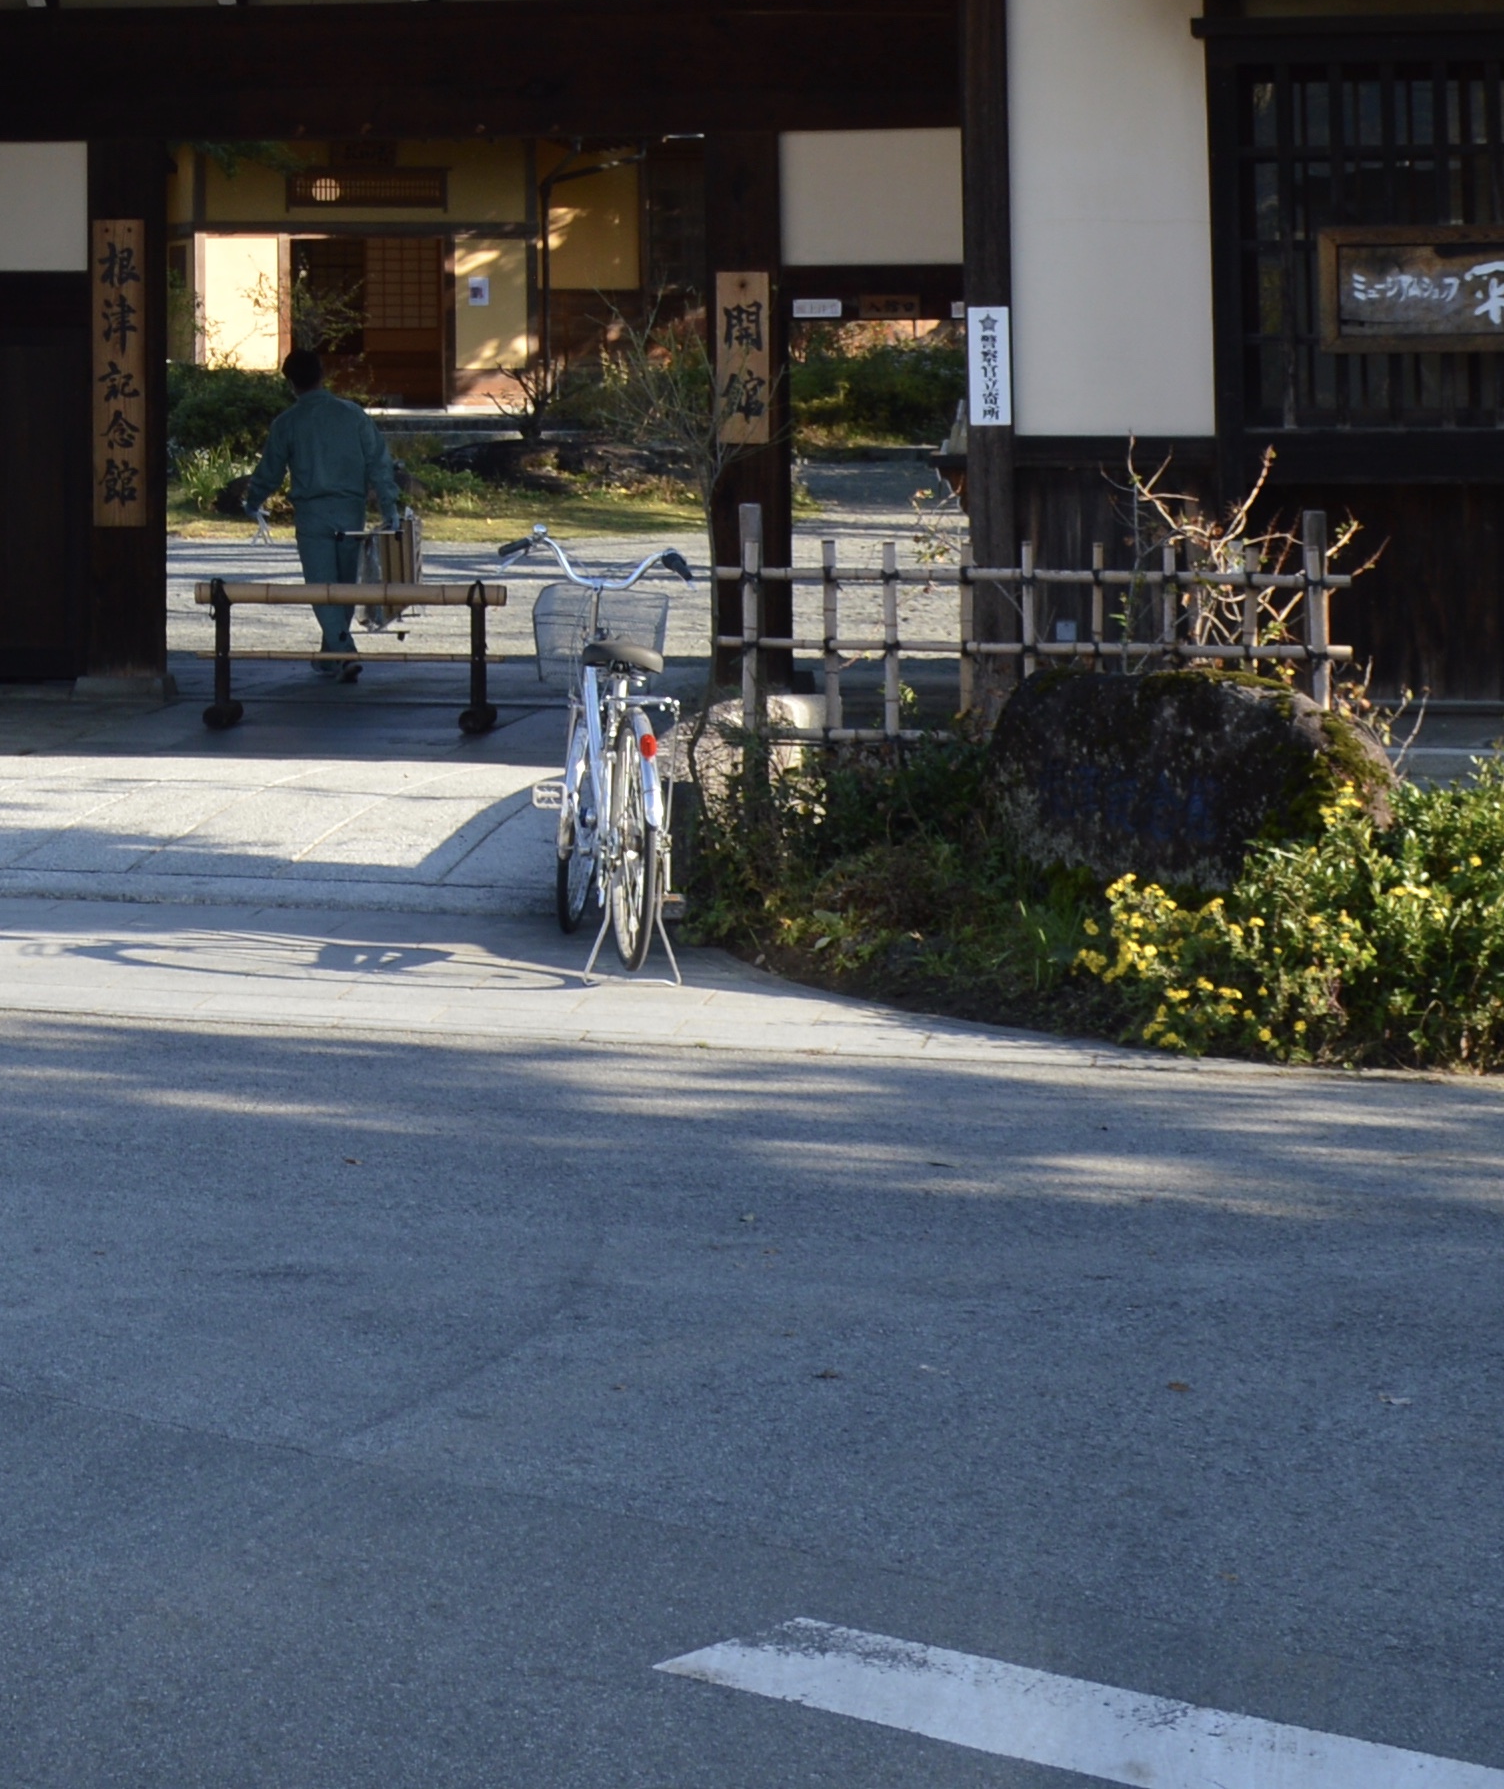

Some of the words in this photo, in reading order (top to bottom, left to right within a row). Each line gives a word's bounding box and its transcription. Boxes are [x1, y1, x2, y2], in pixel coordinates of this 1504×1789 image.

[97, 242, 140, 507] 根津記念館
[722, 300, 766, 424] 開館
[980, 335, 1000, 421] 警察官立寄所
